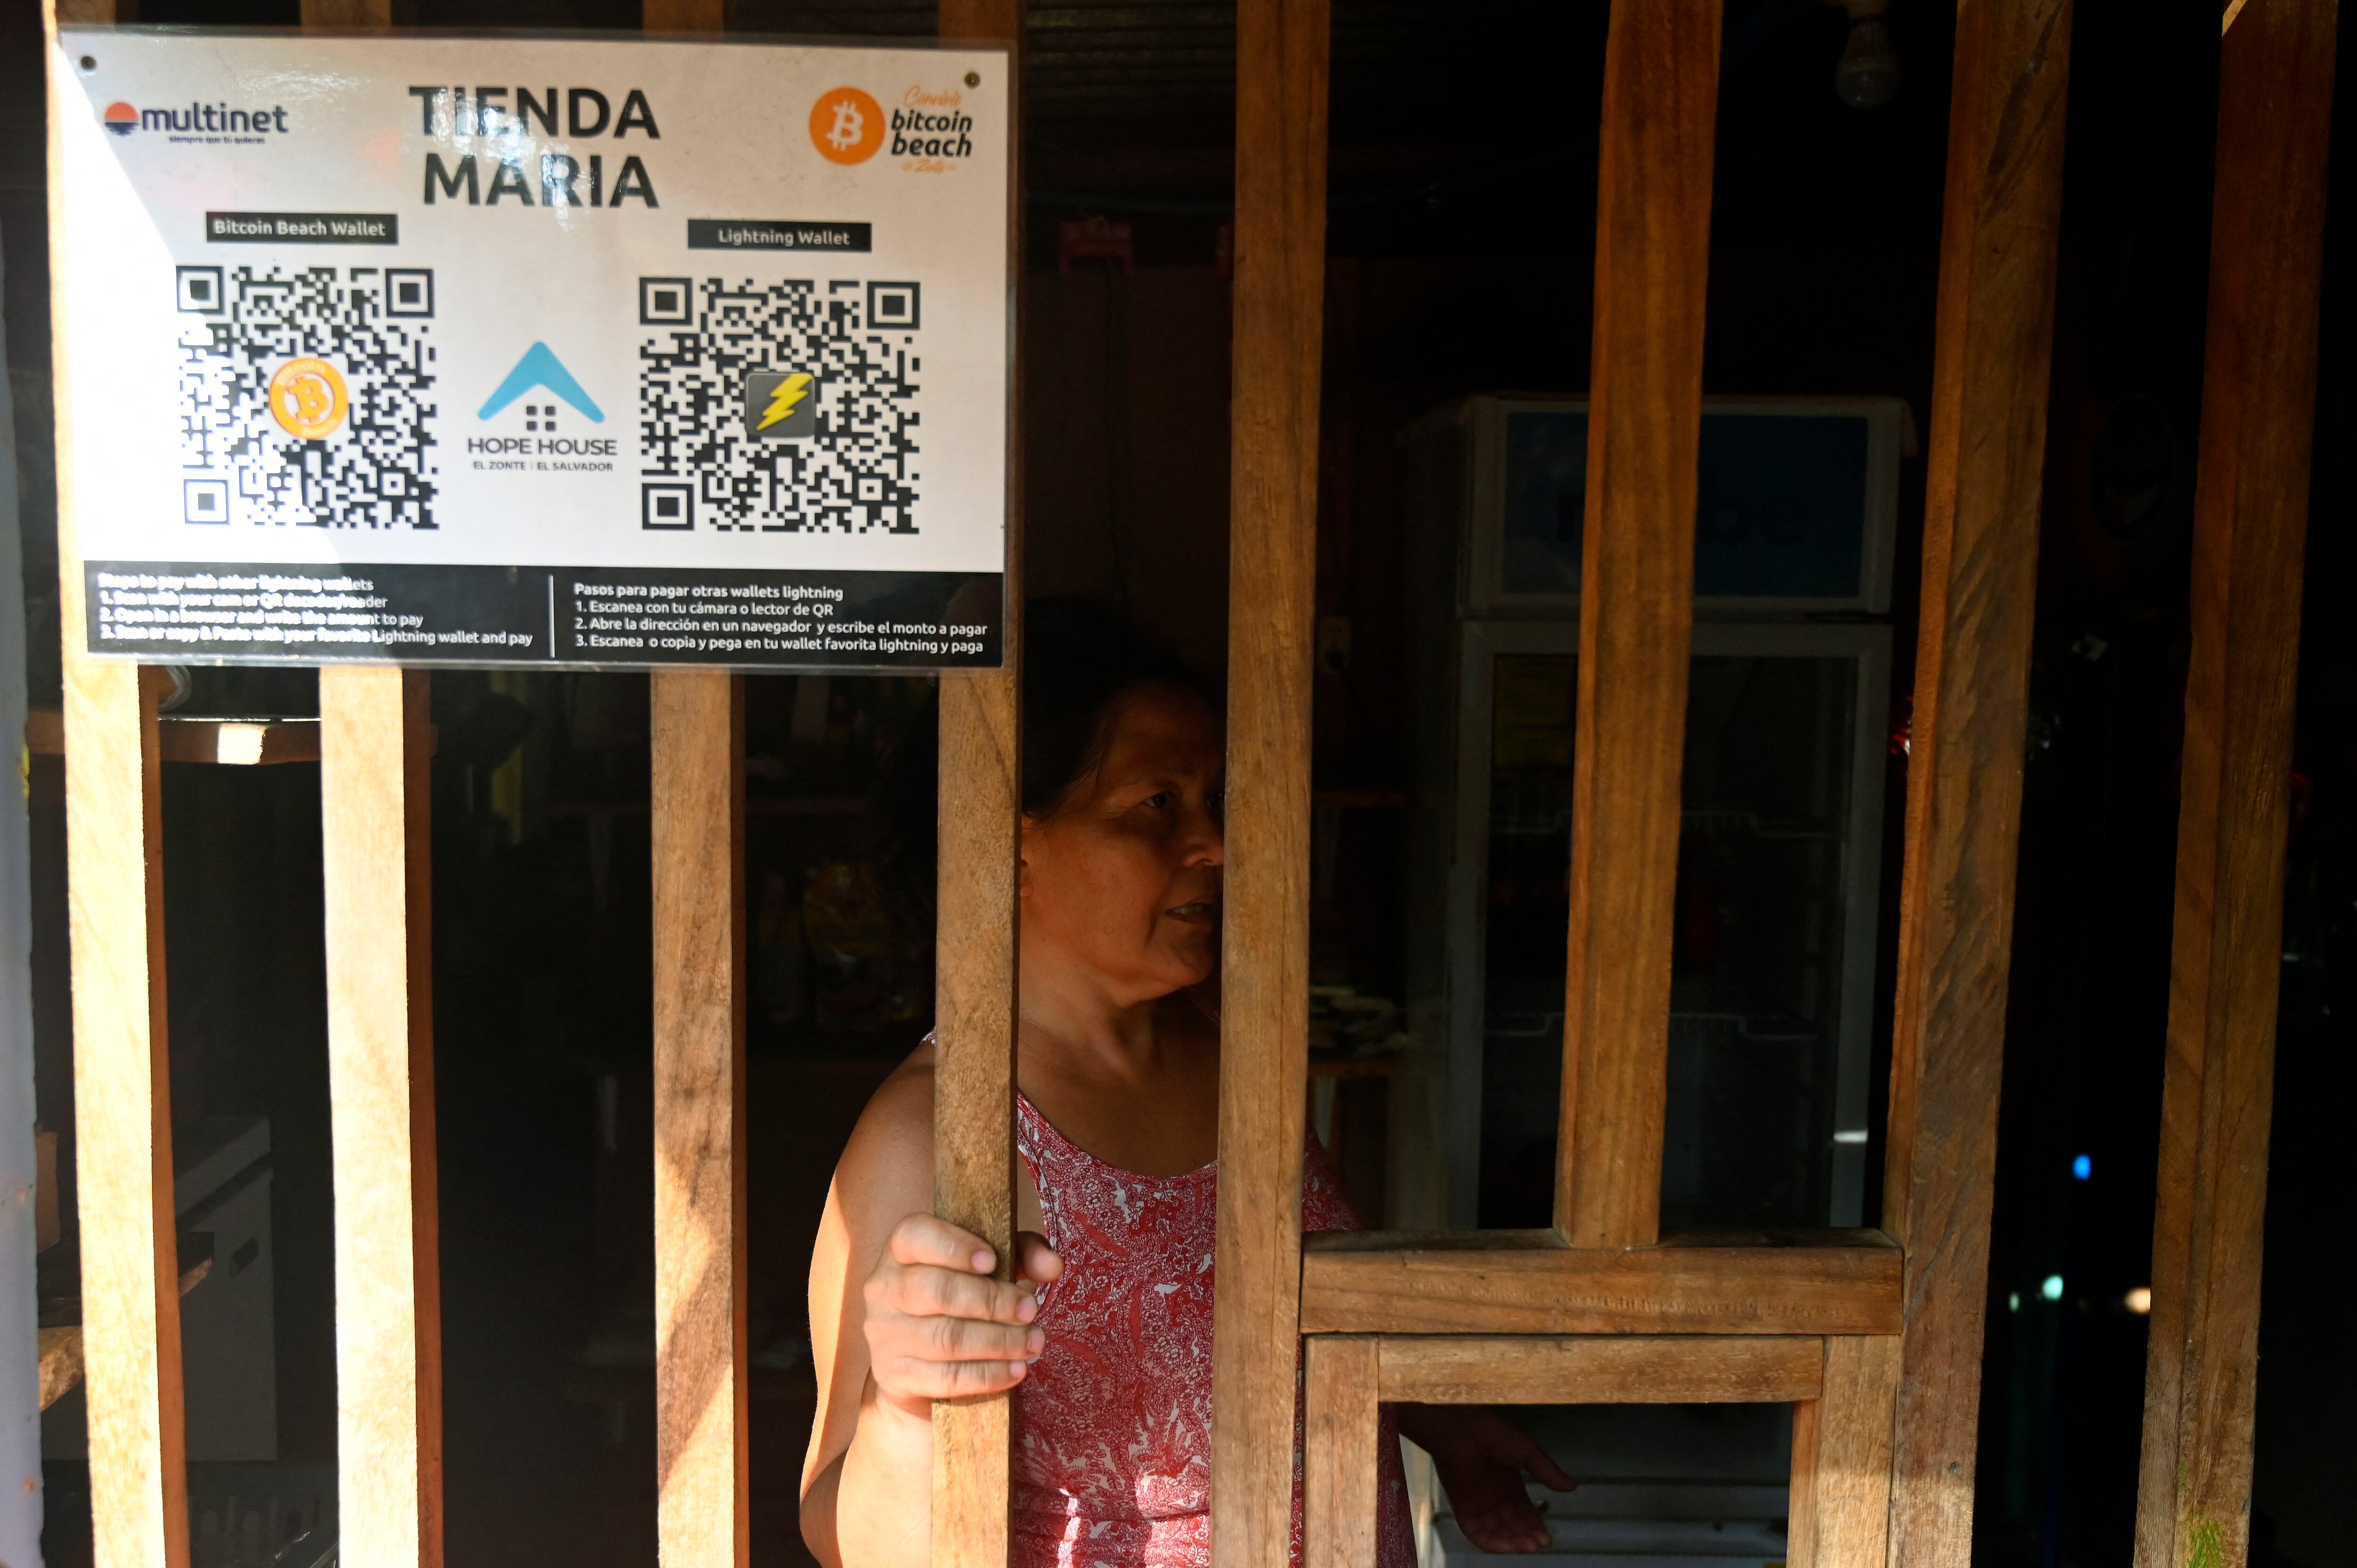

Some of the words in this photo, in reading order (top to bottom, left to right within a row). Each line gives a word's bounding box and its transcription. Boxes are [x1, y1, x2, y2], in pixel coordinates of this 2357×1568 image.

[141, 102, 289, 134] multinet
[408, 86, 661, 140] TIENDA
[891, 109, 972, 132] bitcoin
[891, 132, 972, 157] beach
[424, 152, 659, 208] MARIA
[214, 219, 272, 236] Bitcoin
[277, 220, 328, 236] Beach
[331, 221, 386, 237] Wallet
[718, 228, 794, 247] Lightning
[798, 229, 850, 246] Wallet
[468, 438, 532, 454] HOPE
[538, 438, 618, 456] HOUSE
[473, 461, 486, 470] EL
[489, 461, 526, 470] ZONTE
[537, 462, 549, 471] EL
[553, 462, 613, 471] SALVADOR
[322, 576, 374, 591] wallets
[574, 582, 614, 596] Pasos
[616, 585, 647, 598] para
[650, 585, 689, 599] pagar
[692, 585, 728, 598] otras
[730, 584, 780, 599] wallets
[782, 585, 843, 601] lightning
[259, 592, 283, 609] QR
[575, 600, 587, 613] 1.
[589, 600, 643, 614] Escanea
[645, 603, 669, 614] con
[672, 601, 687, 614] tu
[689, 600, 737, 615] cámara
[740, 605, 749, 615] o
[751, 602, 791, 616] lector
[792, 604, 810, 616] de
[813, 604, 833, 618] QR
[327, 613, 380, 625] amount
[381, 614, 397, 626] to
[398, 615, 423, 628] pay
[574, 616, 587, 630] 2.
[589, 617, 622, 631] Abre
[624, 616, 637, 631] la
[640, 617, 700, 631] dirección
[702, 621, 719, 632] en
[721, 621, 739, 632] un
[742, 620, 812, 634] navegador
[816, 622, 825, 635] y
[827, 620, 874, 634] escribe
[877, 621, 890, 634] el
[893, 623, 937, 635] monto
[939, 624, 947, 635] a
[949, 624, 988, 637] pagar
[371, 628, 436, 646] Lightning
[437, 630, 479, 644] wallet
[480, 631, 506, 644] and
[507, 633, 533, 647] pay
[575, 633, 587, 647] 3.
[589, 633, 643, 648] Escanea
[648, 637, 659, 648] o
[660, 635, 696, 650] copia
[698, 638, 707, 651] y
[709, 638, 742, 651] pega
[744, 638, 761, 649] en
[763, 637, 778, 649] tu
[781, 637, 822, 650] wallet
[824, 637, 876, 651] favorita
[878, 638, 938, 654] lightning
[940, 641, 948, 654] y
[951, 641, 983, 654] paga
